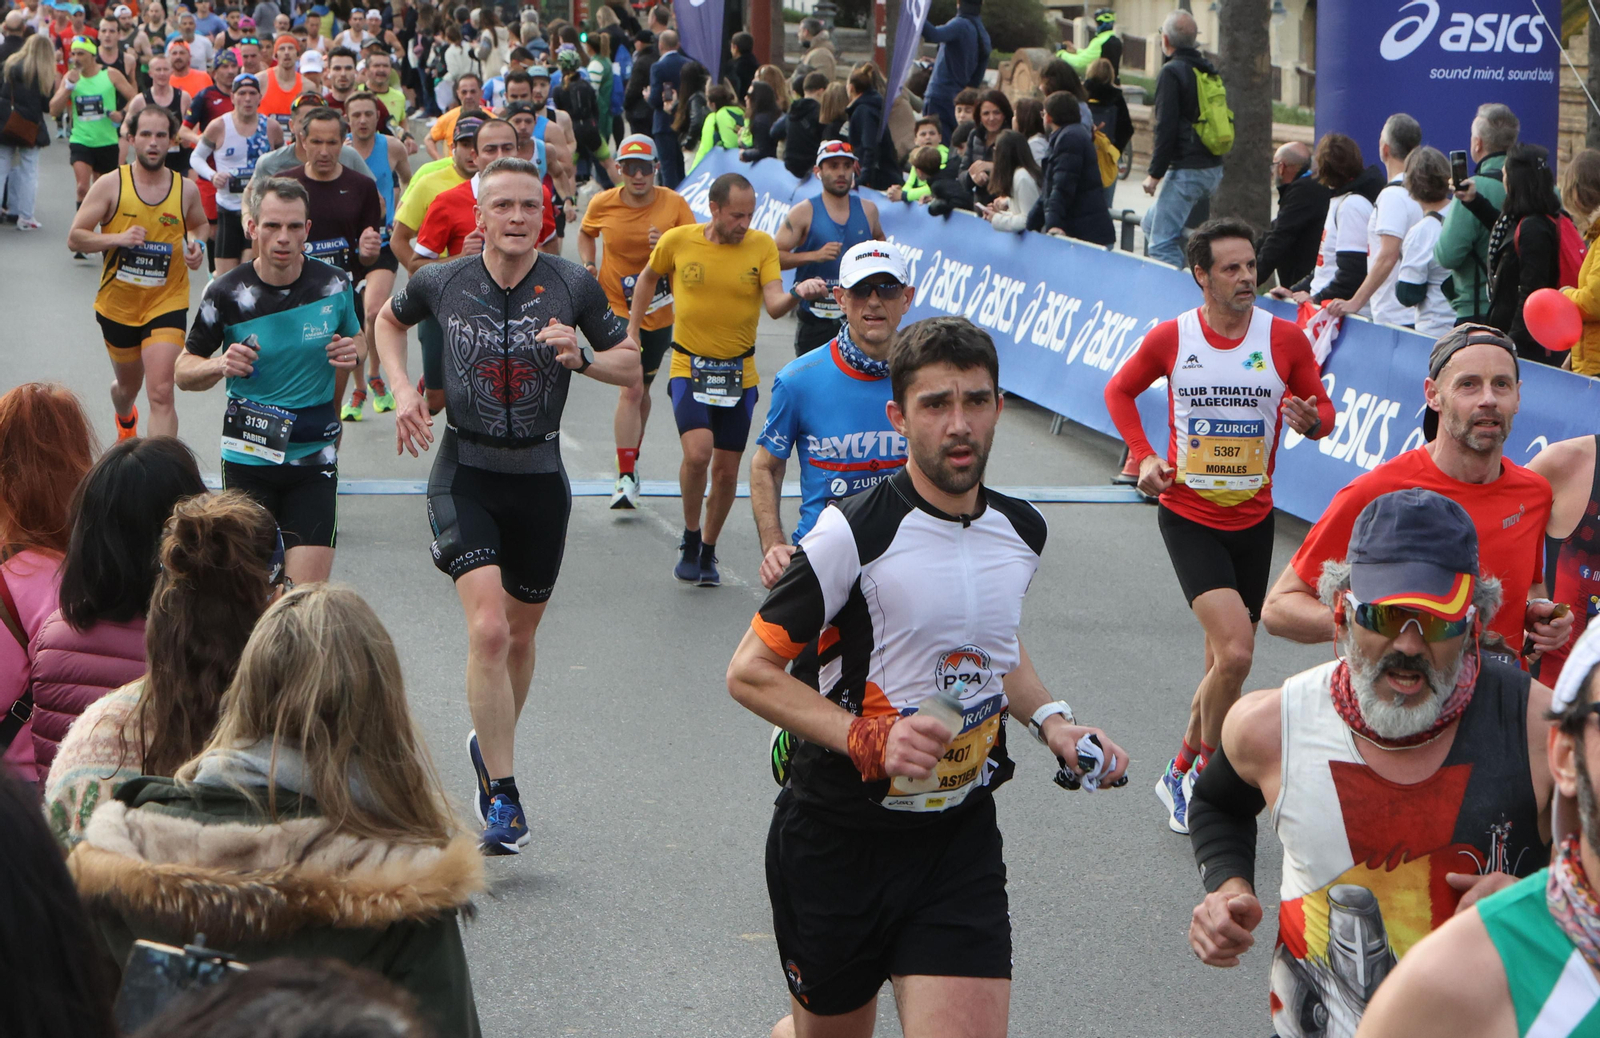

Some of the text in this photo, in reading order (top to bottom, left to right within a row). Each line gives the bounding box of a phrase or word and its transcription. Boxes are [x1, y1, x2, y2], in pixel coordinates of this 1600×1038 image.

[1439, 12, 1546, 53] asics
[1429, 66, 1554, 84] sound mind, sound body
[316, 240, 344, 250] ZURICH
[135, 256, 154, 266] 2914
[930, 258, 974, 315] asics
[521, 297, 541, 312] pwc
[978, 273, 1026, 334] asics
[1031, 290, 1082, 353] asics
[1083, 309, 1138, 372] asics
[706, 375, 726, 384] 2886
[1178, 385, 1272, 398] CLUB TRIATLÓN
[1190, 398, 1259, 408] ALGECIRAS
[245, 415, 269, 430] 3130
[1215, 423, 1259, 434] ZURICH
[1319, 387, 1401, 471] asics
[242, 431, 267, 446] FABIEN
[1213, 446, 1241, 458] 5387
[1205, 464, 1247, 474] MORALES
[464, 555, 490, 567] HOTEL
[943, 671, 982, 690] PPA
[962, 701, 994, 730] RICH
[938, 744, 972, 763] 407
[938, 765, 978, 789] ASTIEN
